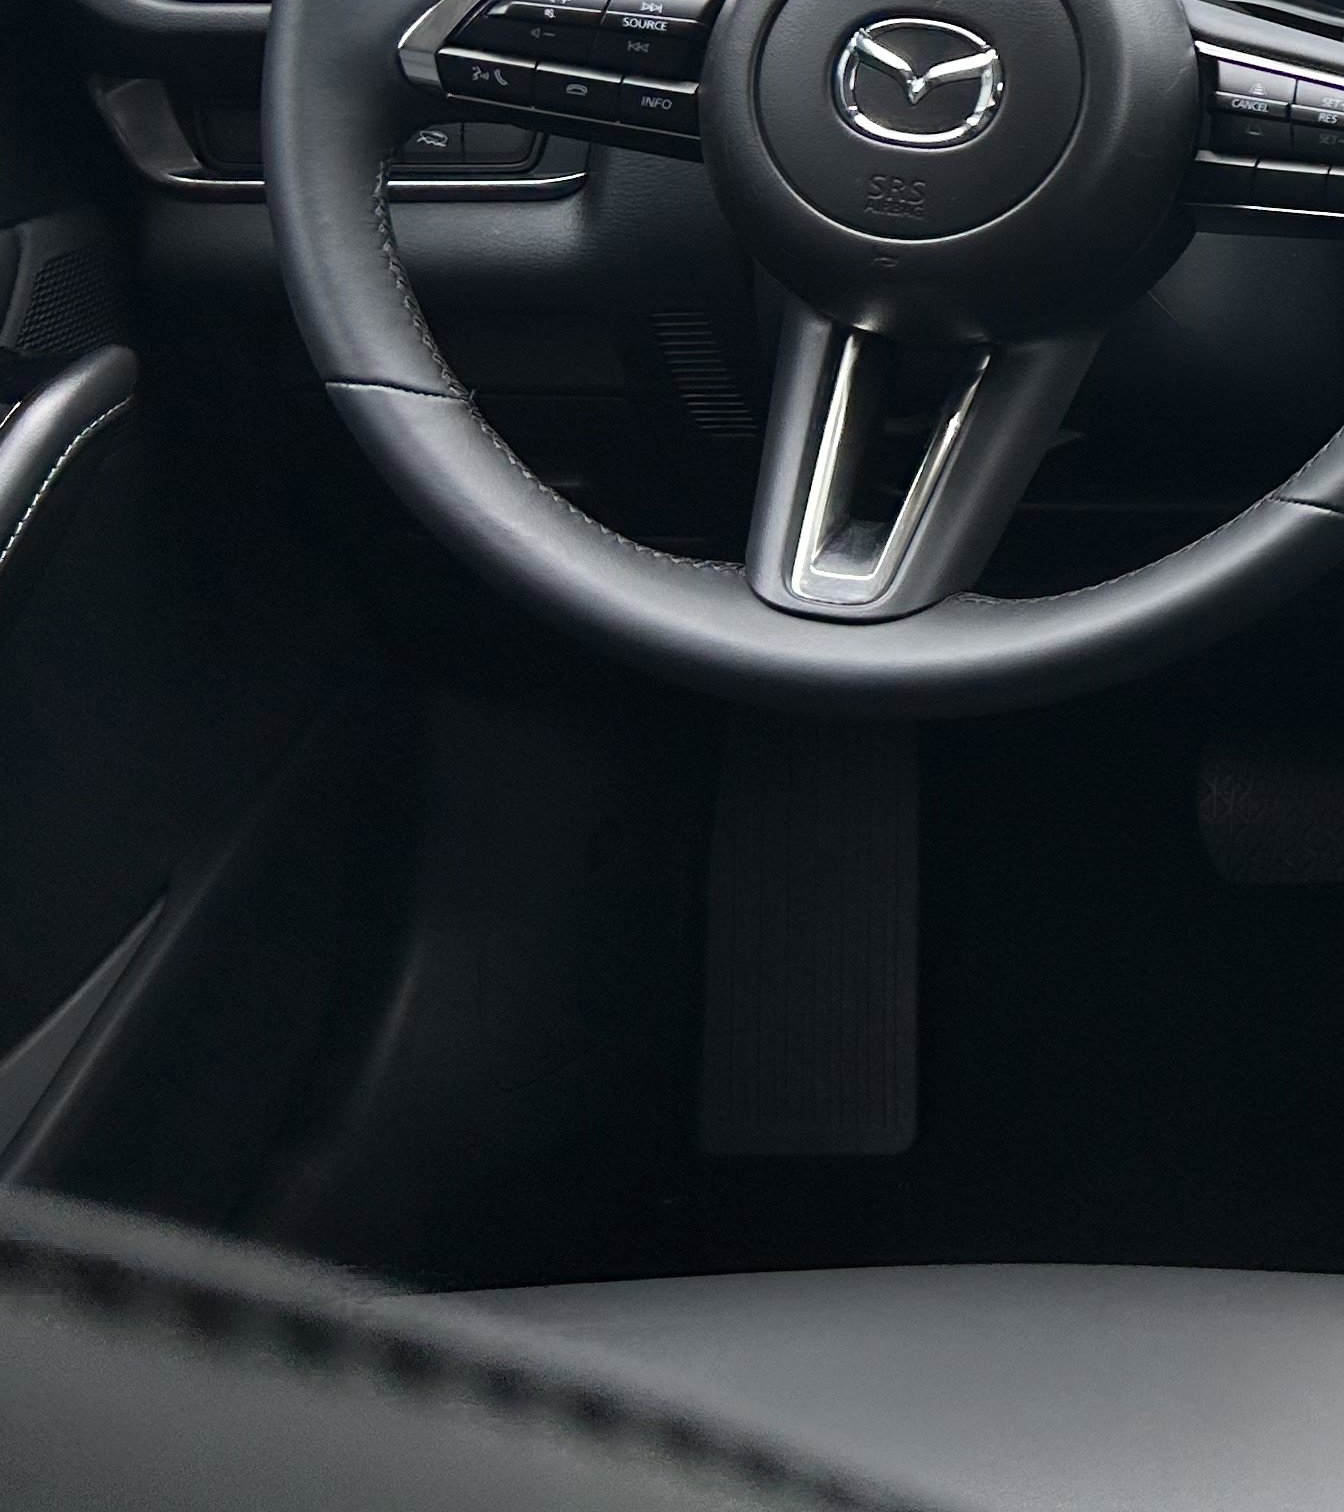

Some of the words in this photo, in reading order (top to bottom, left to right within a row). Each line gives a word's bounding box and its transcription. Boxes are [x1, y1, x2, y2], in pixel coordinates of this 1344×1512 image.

[622, 16, 668, 33] SOURCE
[641, 95, 673, 111] INFO
[1231, 98, 1270, 115] CANCEL
[1317, 113, 1339, 125] RES
[866, 174, 926, 205] SRS
